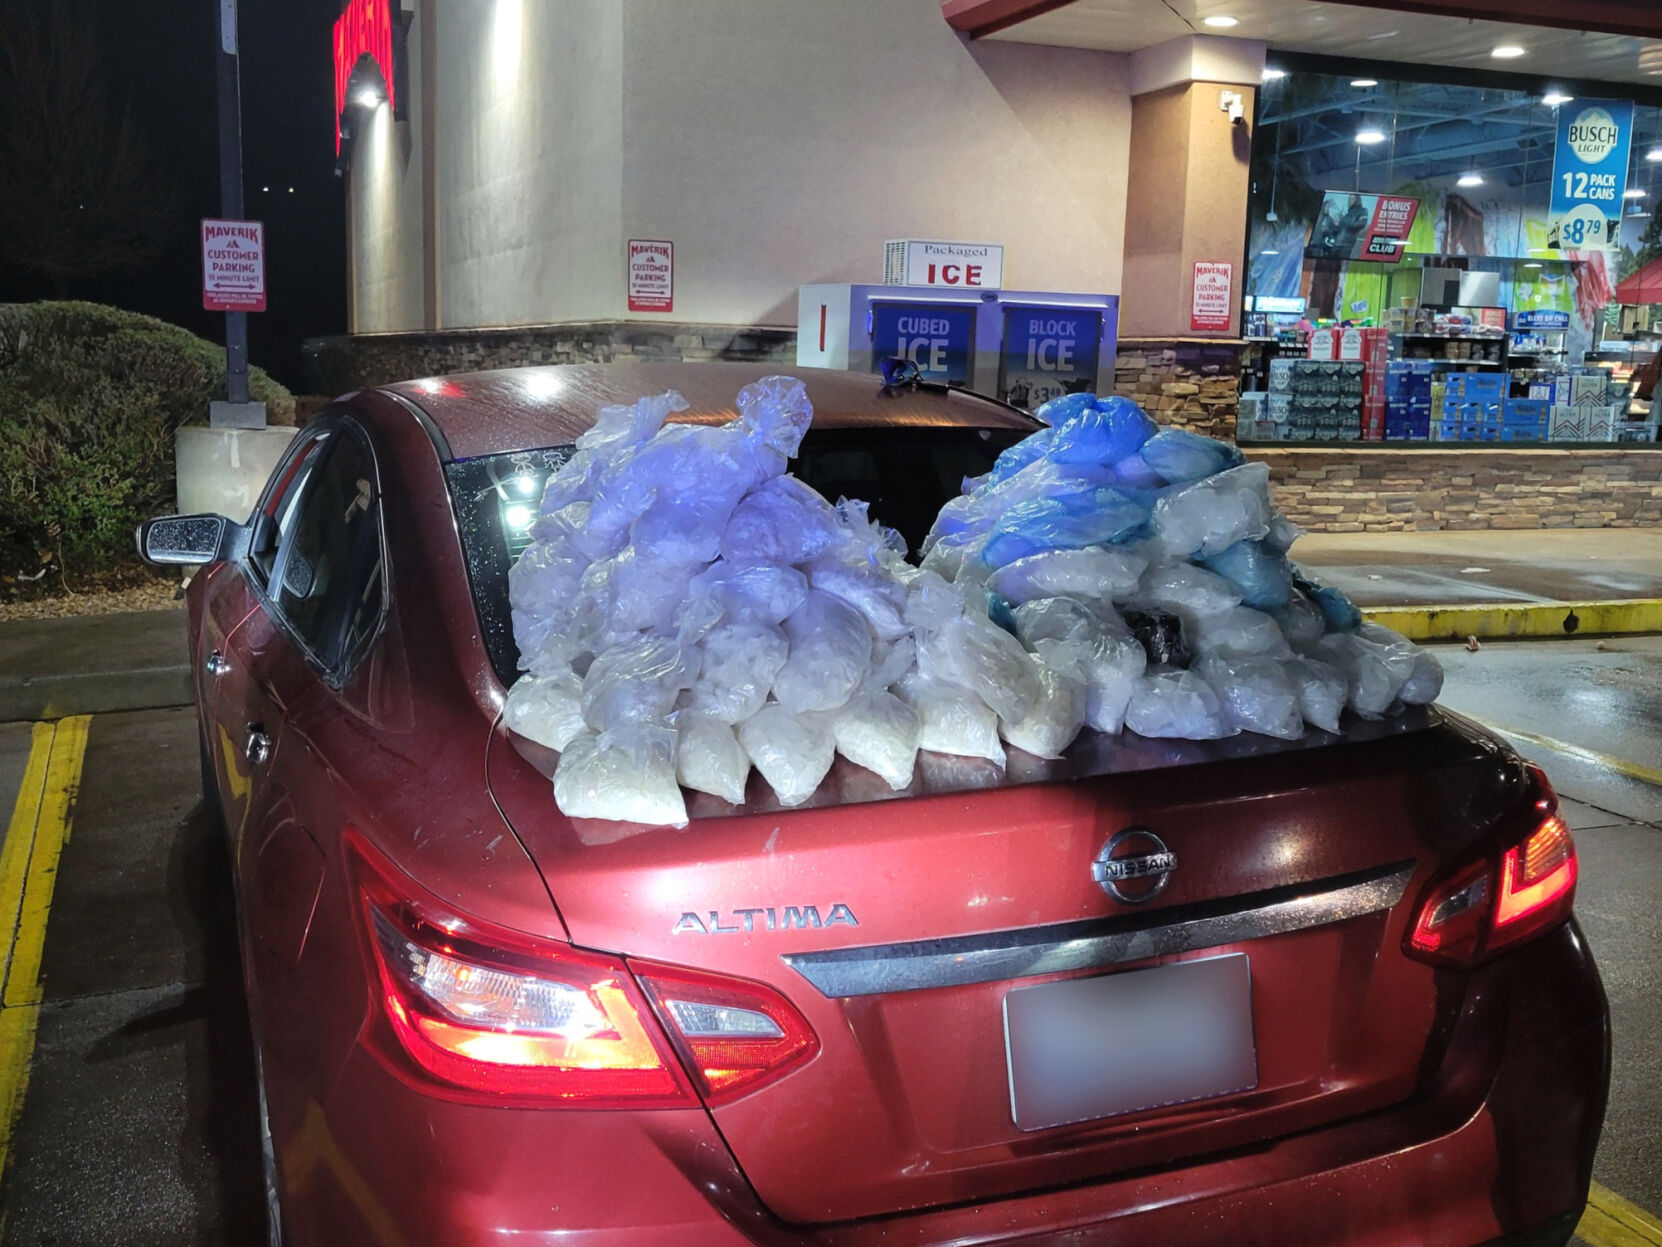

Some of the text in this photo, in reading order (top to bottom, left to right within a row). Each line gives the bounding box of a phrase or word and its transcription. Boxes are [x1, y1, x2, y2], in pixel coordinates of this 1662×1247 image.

[1569, 125, 1617, 144] BUSCH
[1577, 143, 1606, 153] LIGHT
[1563, 172, 1616, 199] 12 PACK
[1589, 188, 1615, 200] CANS
[1382, 200, 1411, 211] BONUS
[1379, 210, 1408, 220] ENTRIES
[205, 226, 258, 244] MAVERIK
[208, 249, 259, 261] CUSTOMER
[631, 245, 669, 259] MAVERIK
[924, 244, 988, 257] Packaged
[1369, 244, 1395, 253] CLUB
[212, 262, 255, 273] PARKING
[632, 264, 669, 272] CUSTOMER
[1196, 267, 1229, 279] MAVERIK
[635, 273, 666, 282] PARKING
[927, 264, 982, 286] ICE
[1198, 293, 1225, 301] PARKING
[898, 316, 950, 336] CUBED
[1029, 319, 1077, 337] BLOCK
[897, 337, 949, 372] ICE
[1027, 338, 1075, 372] ICE
[1104, 856, 1171, 877] NISSAN
[672, 902, 860, 936] ALTIMA
